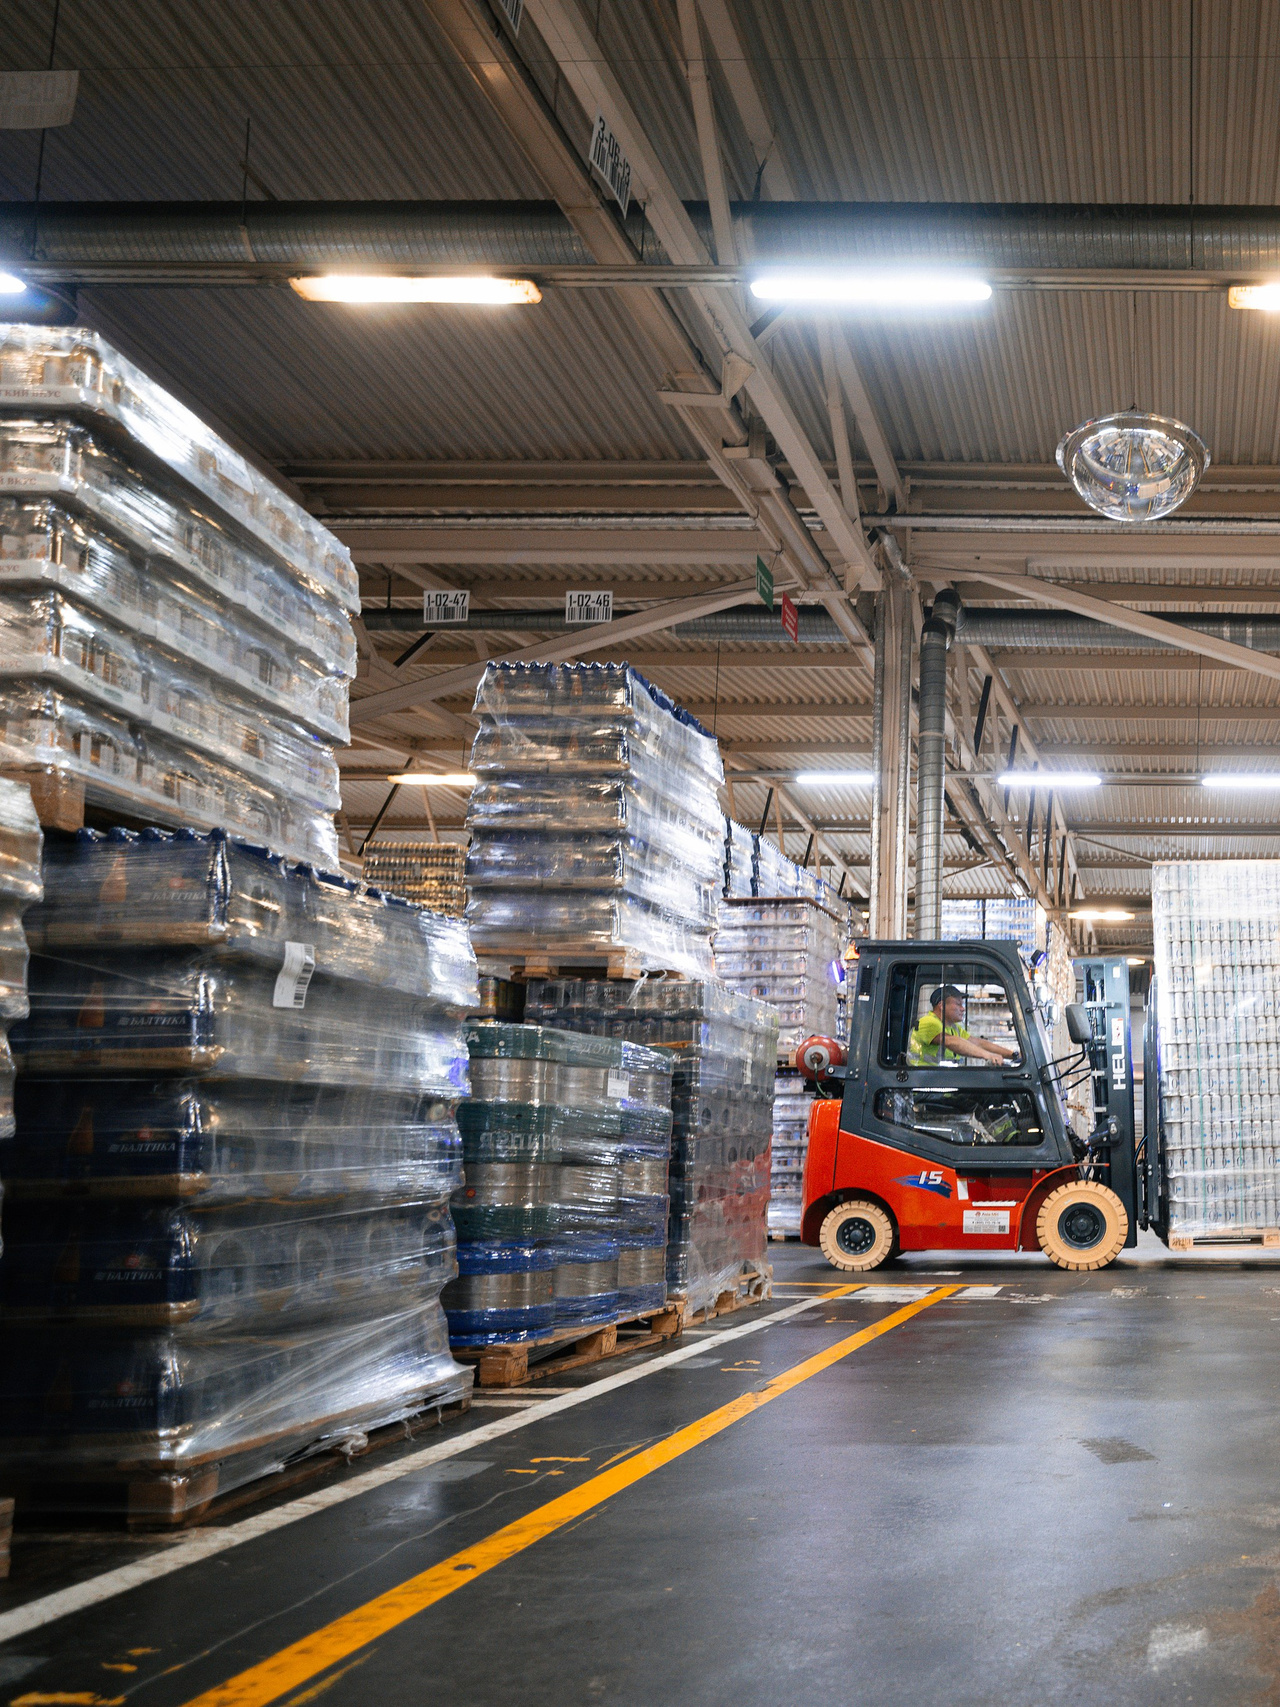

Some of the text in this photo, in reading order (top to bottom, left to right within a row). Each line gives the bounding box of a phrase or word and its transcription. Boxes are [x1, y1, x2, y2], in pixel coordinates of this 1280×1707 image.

[427, 593, 467, 606] 1-02-47
[569, 594, 610, 607] 1-02-46
[130, 1015, 187, 1025] БАЛТИКА
[120, 1142, 176, 1152] БАЛТИКА
[918, 1170, 944, 1185] 15
[106, 1271, 163, 1281] БАЛТИКА
